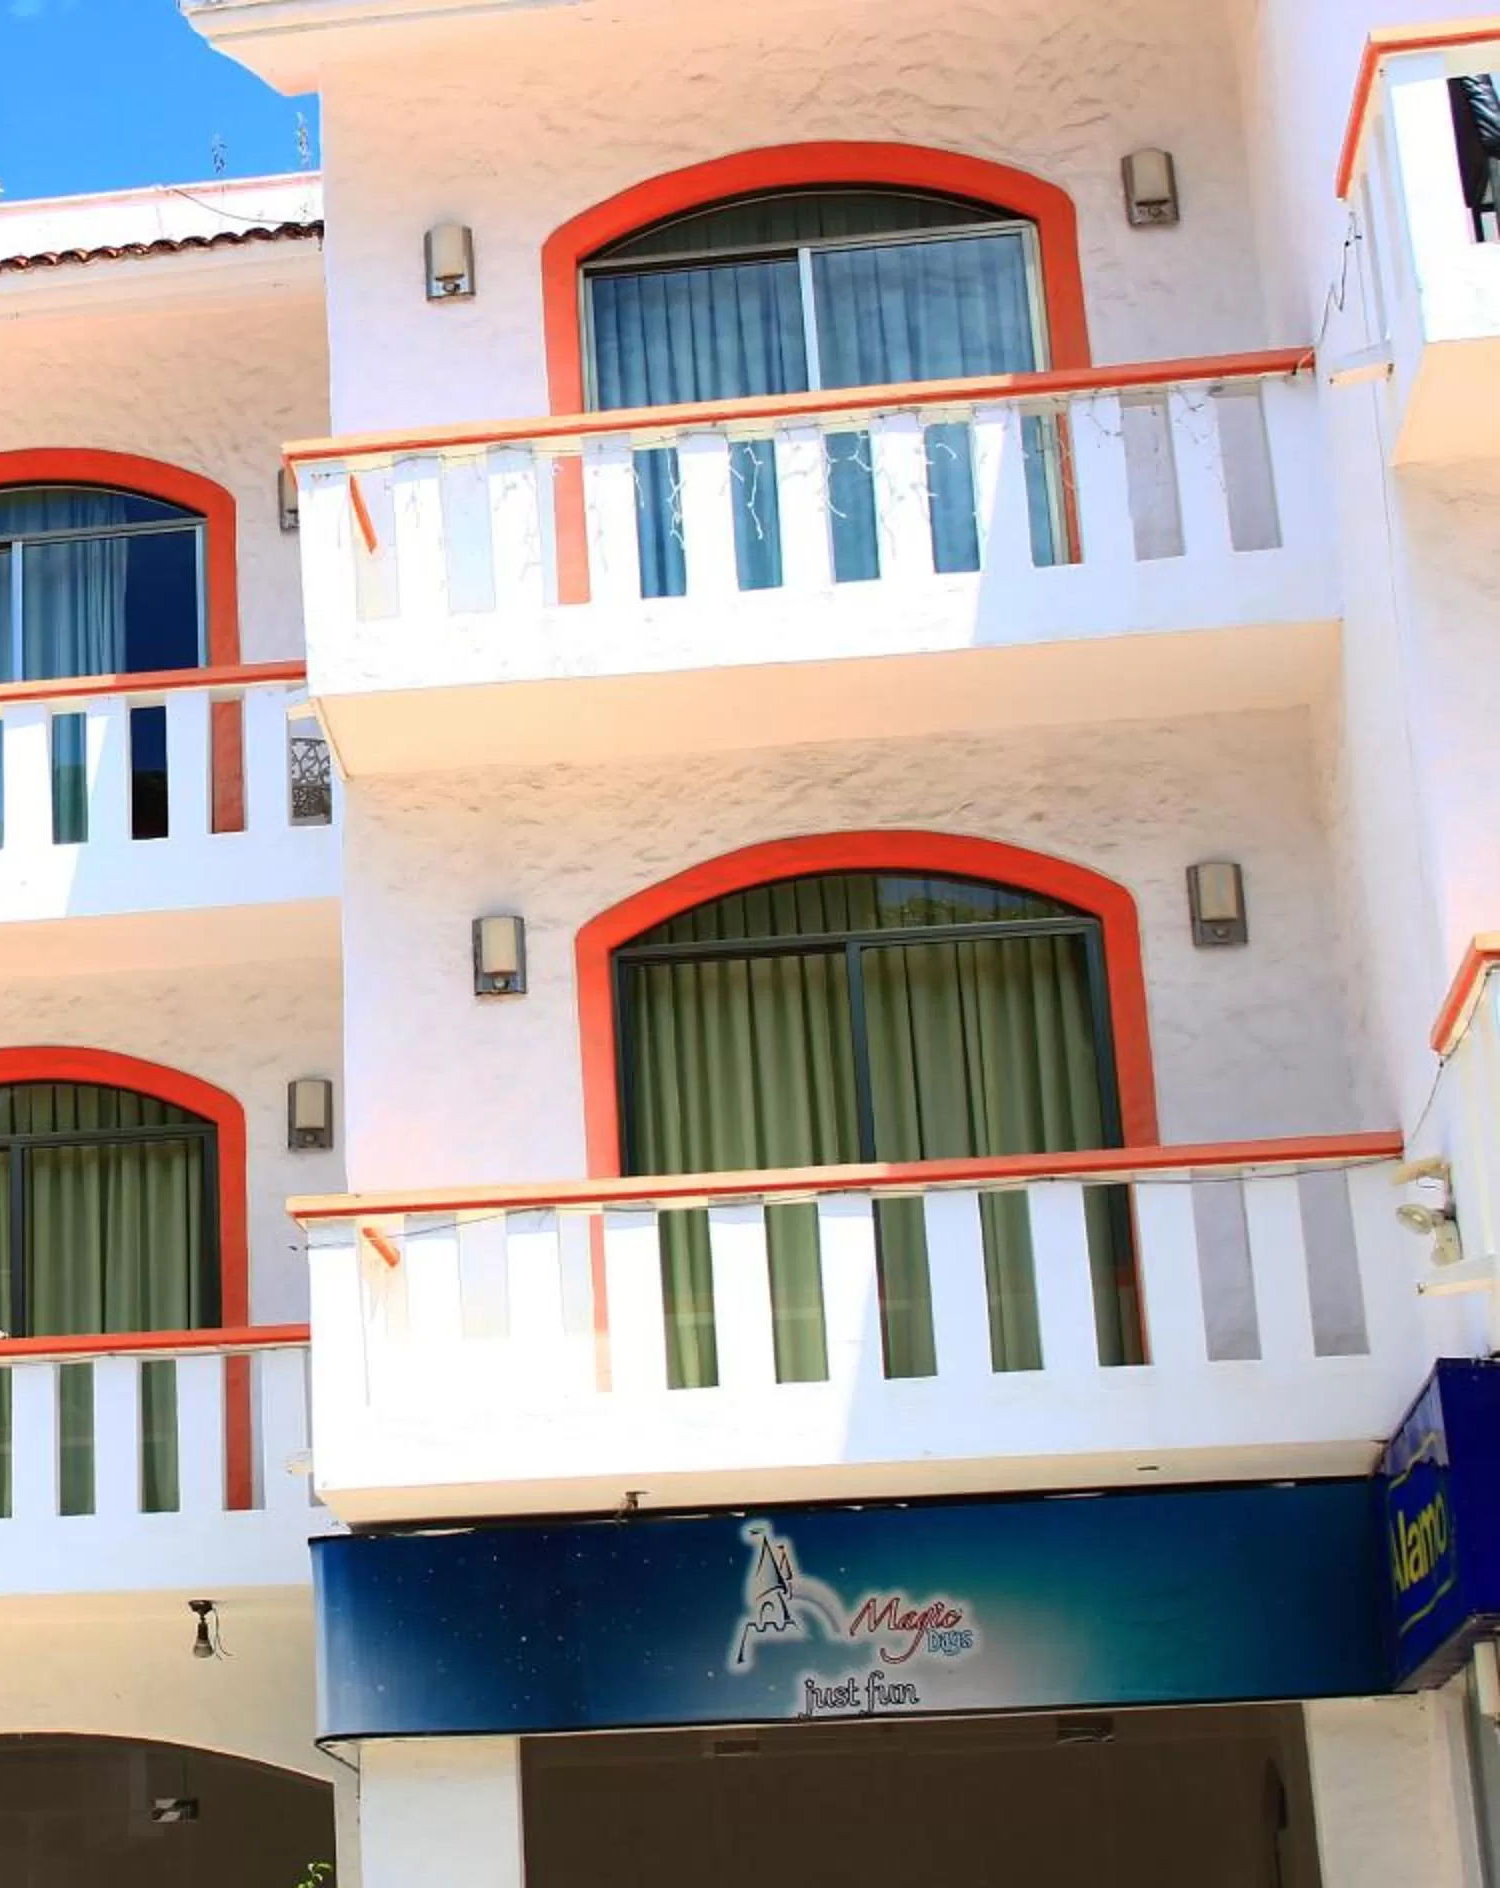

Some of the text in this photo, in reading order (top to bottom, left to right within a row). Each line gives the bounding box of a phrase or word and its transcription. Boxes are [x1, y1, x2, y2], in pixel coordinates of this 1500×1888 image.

[849, 1597, 962, 1664] Magic
[798, 1669, 921, 1719] just fun
